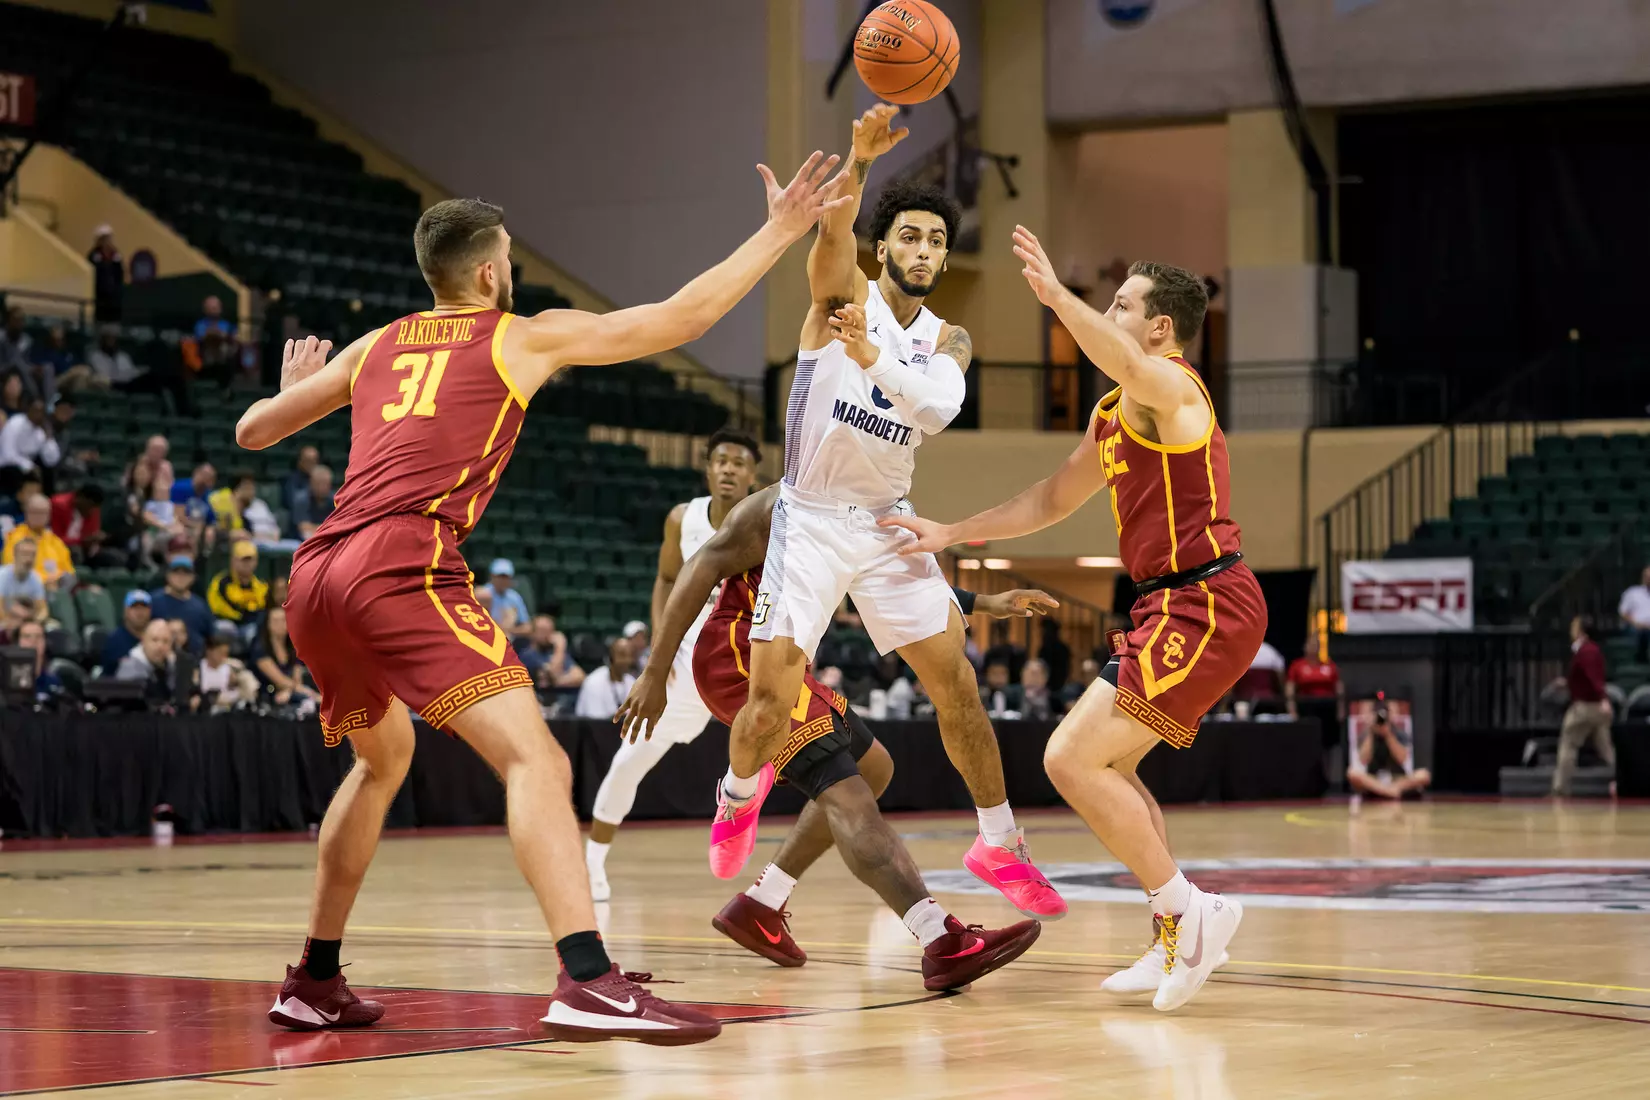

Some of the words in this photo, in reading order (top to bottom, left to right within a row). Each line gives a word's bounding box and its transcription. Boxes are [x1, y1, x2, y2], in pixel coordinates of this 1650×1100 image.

[395, 318, 476, 345] RAKOCEVIC
[381, 350, 452, 423] 31
[1352, 579, 1466, 612] ESPN
